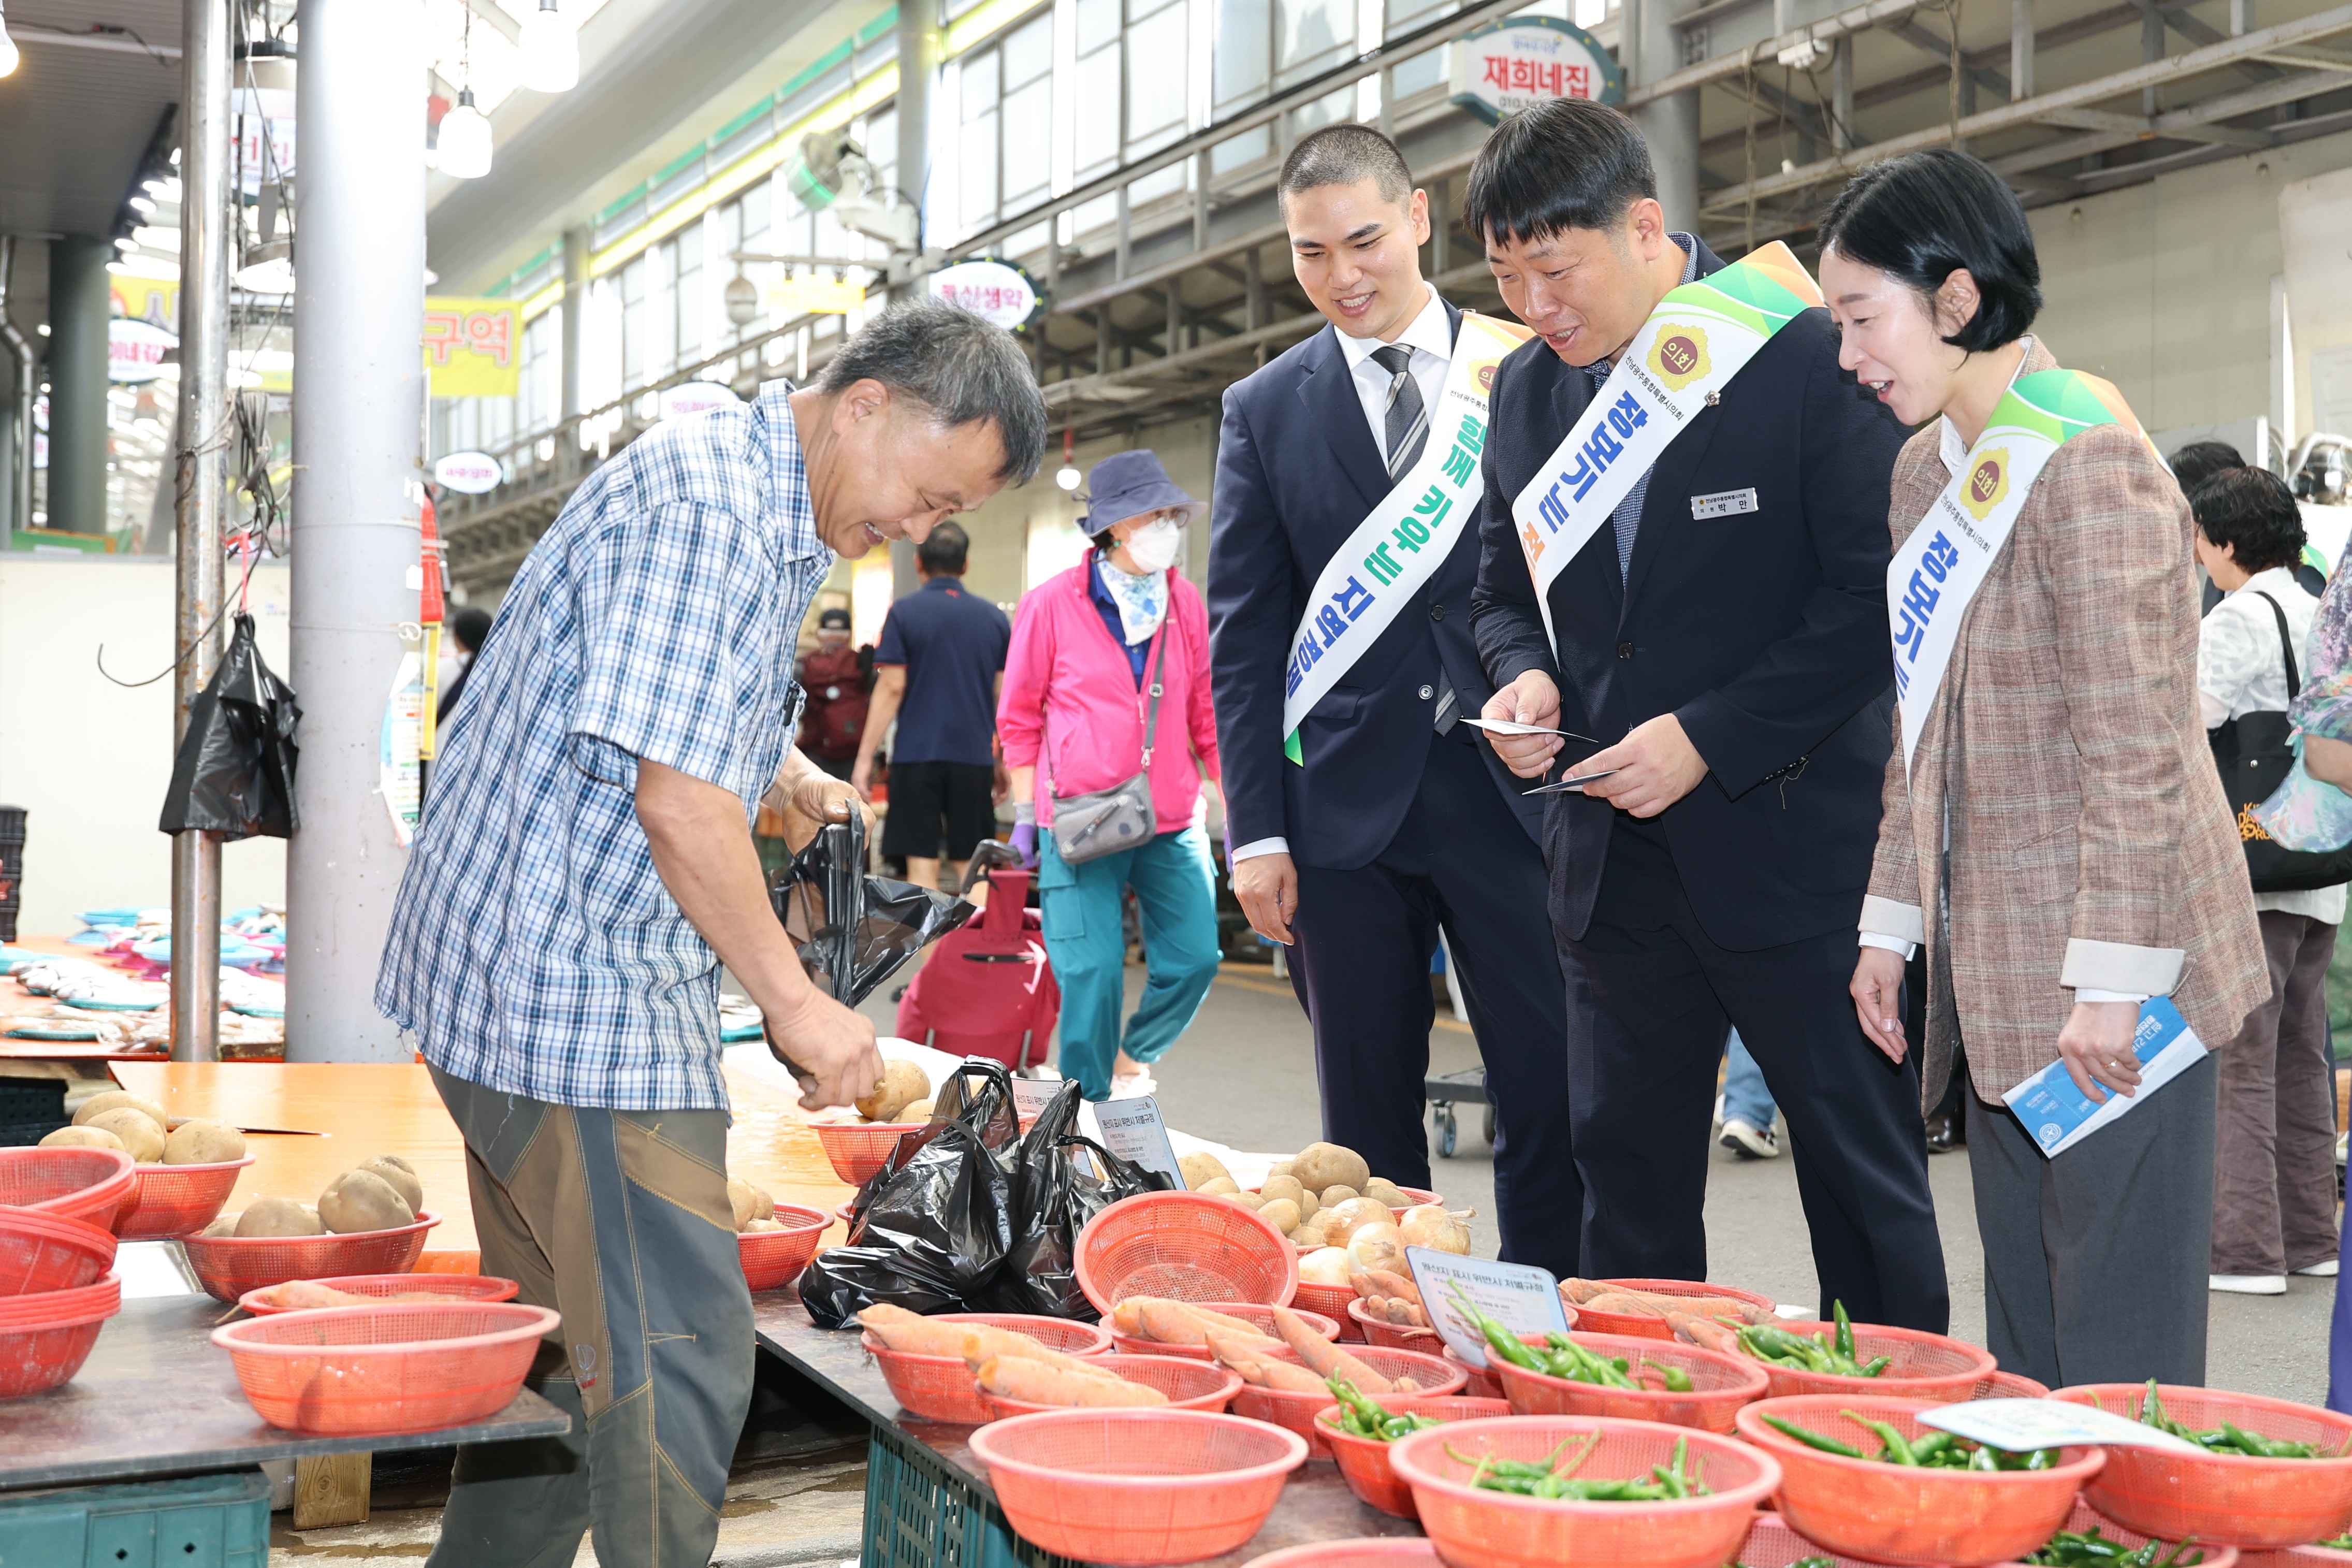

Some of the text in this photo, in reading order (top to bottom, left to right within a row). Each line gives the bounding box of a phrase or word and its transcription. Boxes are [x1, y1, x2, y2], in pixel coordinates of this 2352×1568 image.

[1484, 56, 1589, 99] 재희네집
[1662, 342, 1695, 372] 의회
[1479, 371, 1493, 384] 의
[1624, 355, 1685, 421] 전남광주통합특별시의회
[1450, 390, 1489, 412] 전남광주통합
[1538, 389, 1649, 534] 장보기는
[1705, 493, 1747, 504] 전남광주통합특별시의회
[1973, 469, 1996, 498] 의회
[1940, 493, 1991, 554] 전남광주통합특별시의회
[1287, 413, 1488, 701] 함께 키우는 지역경제
[1015, 1094, 1026, 1104] 원산지
[1026, 1096, 1035, 1105] 표시
[1034, 1096, 1047, 1106] 위반시
[1102, 1113, 1155, 1129] 원산지 표시 위반시 처벌규정
[1421, 1261, 1449, 1276] 원산지
[1452, 1269, 1471, 1281] 표시
[1472, 1273, 1502, 1287] 위반시
[1504, 1277, 1544, 1292] 처벌규정
